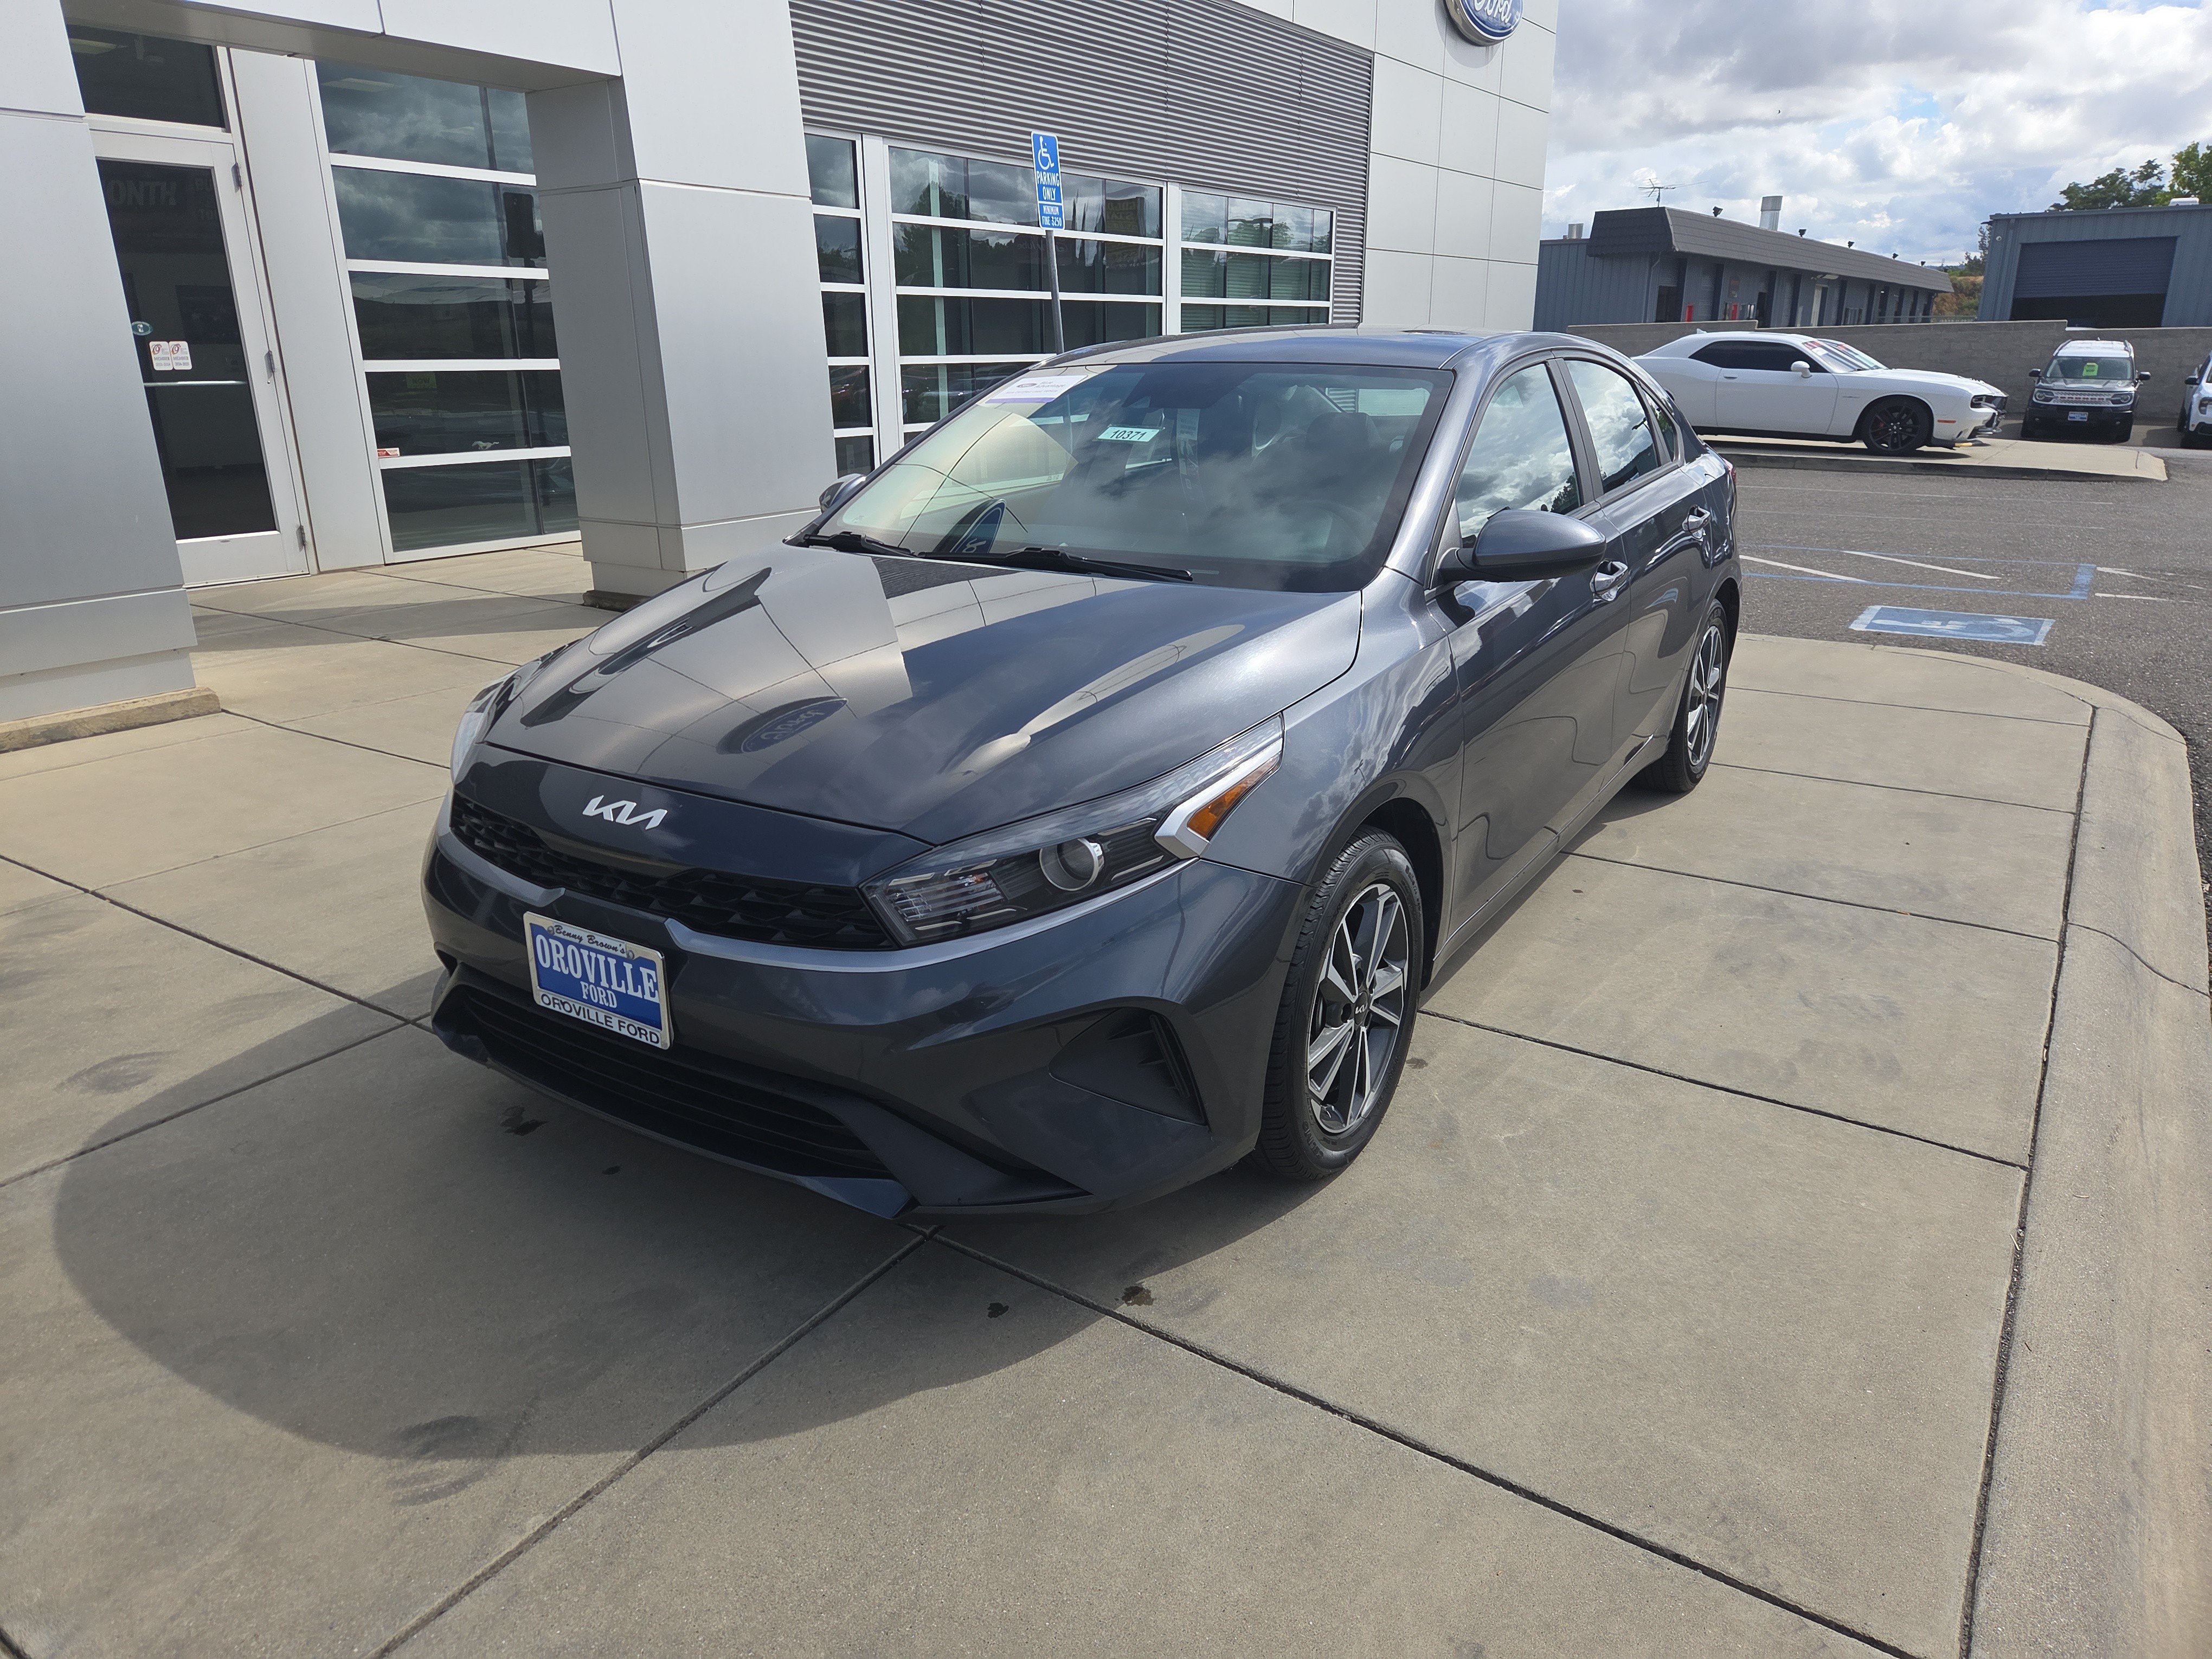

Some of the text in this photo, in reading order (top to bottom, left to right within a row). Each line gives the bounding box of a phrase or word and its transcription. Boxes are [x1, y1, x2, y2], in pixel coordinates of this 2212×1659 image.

[104, 179, 177, 205] ONTH
[1037, 171, 1060, 187] PARKING
[1043, 187, 1056, 201] ONLY
[1110, 430, 1147, 440] 10371
[582, 795, 668, 830] KIA
[554, 924, 626, 954] Benny Brown's
[536, 934, 660, 1004] OROVILLE
[580, 981, 618, 1008] FORD
[541, 994, 660, 1044] OROVILLE FORD
